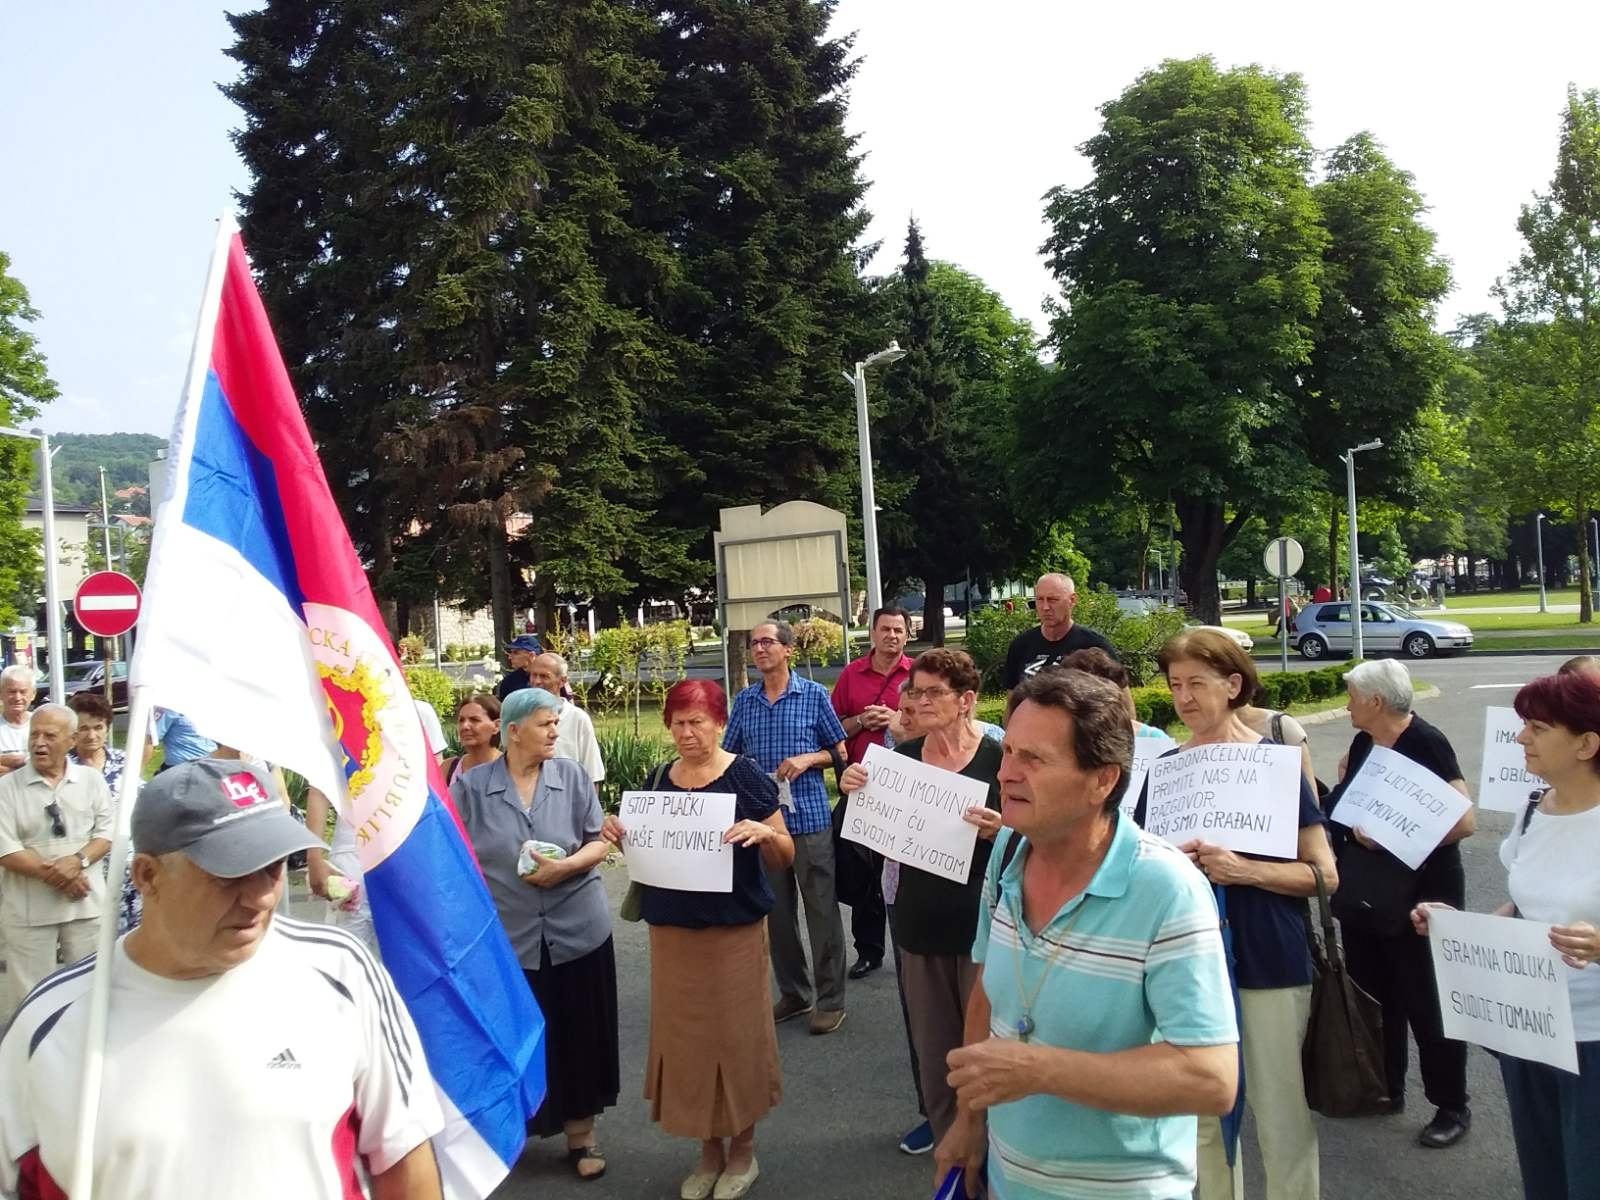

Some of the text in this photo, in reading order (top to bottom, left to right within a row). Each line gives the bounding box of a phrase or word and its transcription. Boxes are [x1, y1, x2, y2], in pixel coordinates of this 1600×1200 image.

[1152, 768, 1258, 800] PRIMITE NAS NA
[627, 796, 656, 815] STOP
[855, 791, 926, 831] BRANIT ĆU
[1171, 813, 1198, 833] SMO
[1202, 811, 1272, 833] GRAĐANI
[1367, 799, 1421, 838] IMOVINE
[623, 825, 655, 848] NAŠE
[851, 818, 966, 875] SVOJIM ŽIVOTOM
[1441, 939, 1557, 982] SRAMNA ODLUKA
[1496, 1002, 1556, 1038] TOMANIĆ
